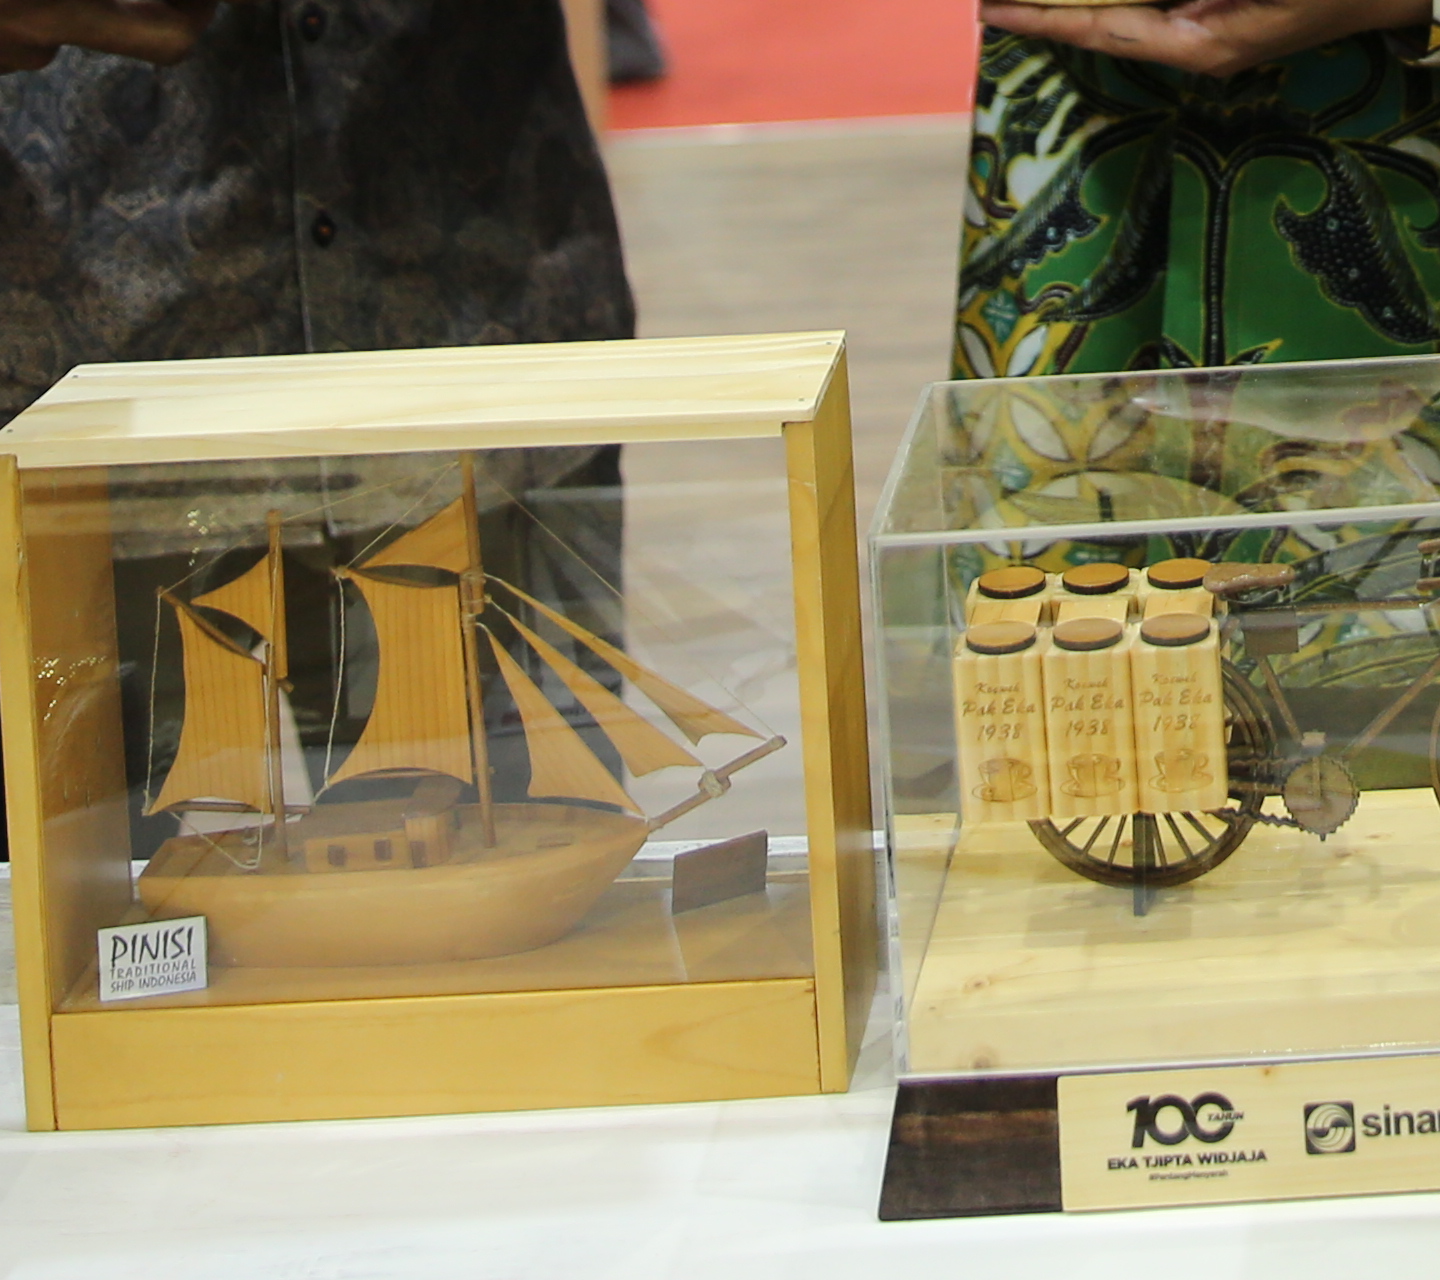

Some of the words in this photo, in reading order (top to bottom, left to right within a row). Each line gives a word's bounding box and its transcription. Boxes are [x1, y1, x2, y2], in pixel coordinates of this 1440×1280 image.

[961, 700, 997, 718] Pak
[1001, 698, 1037, 715] Eka
[1049, 696, 1086, 713] Pak
[1090, 693, 1125, 710] Eka
[1138, 690, 1173, 707] Pak
[1178, 689, 1214, 706] Eka
[976, 723, 1023, 741] 1938
[1064, 718, 1110, 737] 1938
[1152, 713, 1201, 733] 1938
[111, 925, 194, 969] PINISI
[110, 958, 197, 980] TRADITIONAL
[110, 978, 135, 994] SHIP
[138, 971, 197, 989] INDONESIA
[1126, 1091, 1235, 1149] 100
[1107, 1156, 1139, 1171] EKA
[1142, 1153, 1194, 1168] TJIPTA
[1196, 1149, 1268, 1165] WIDJAJA
